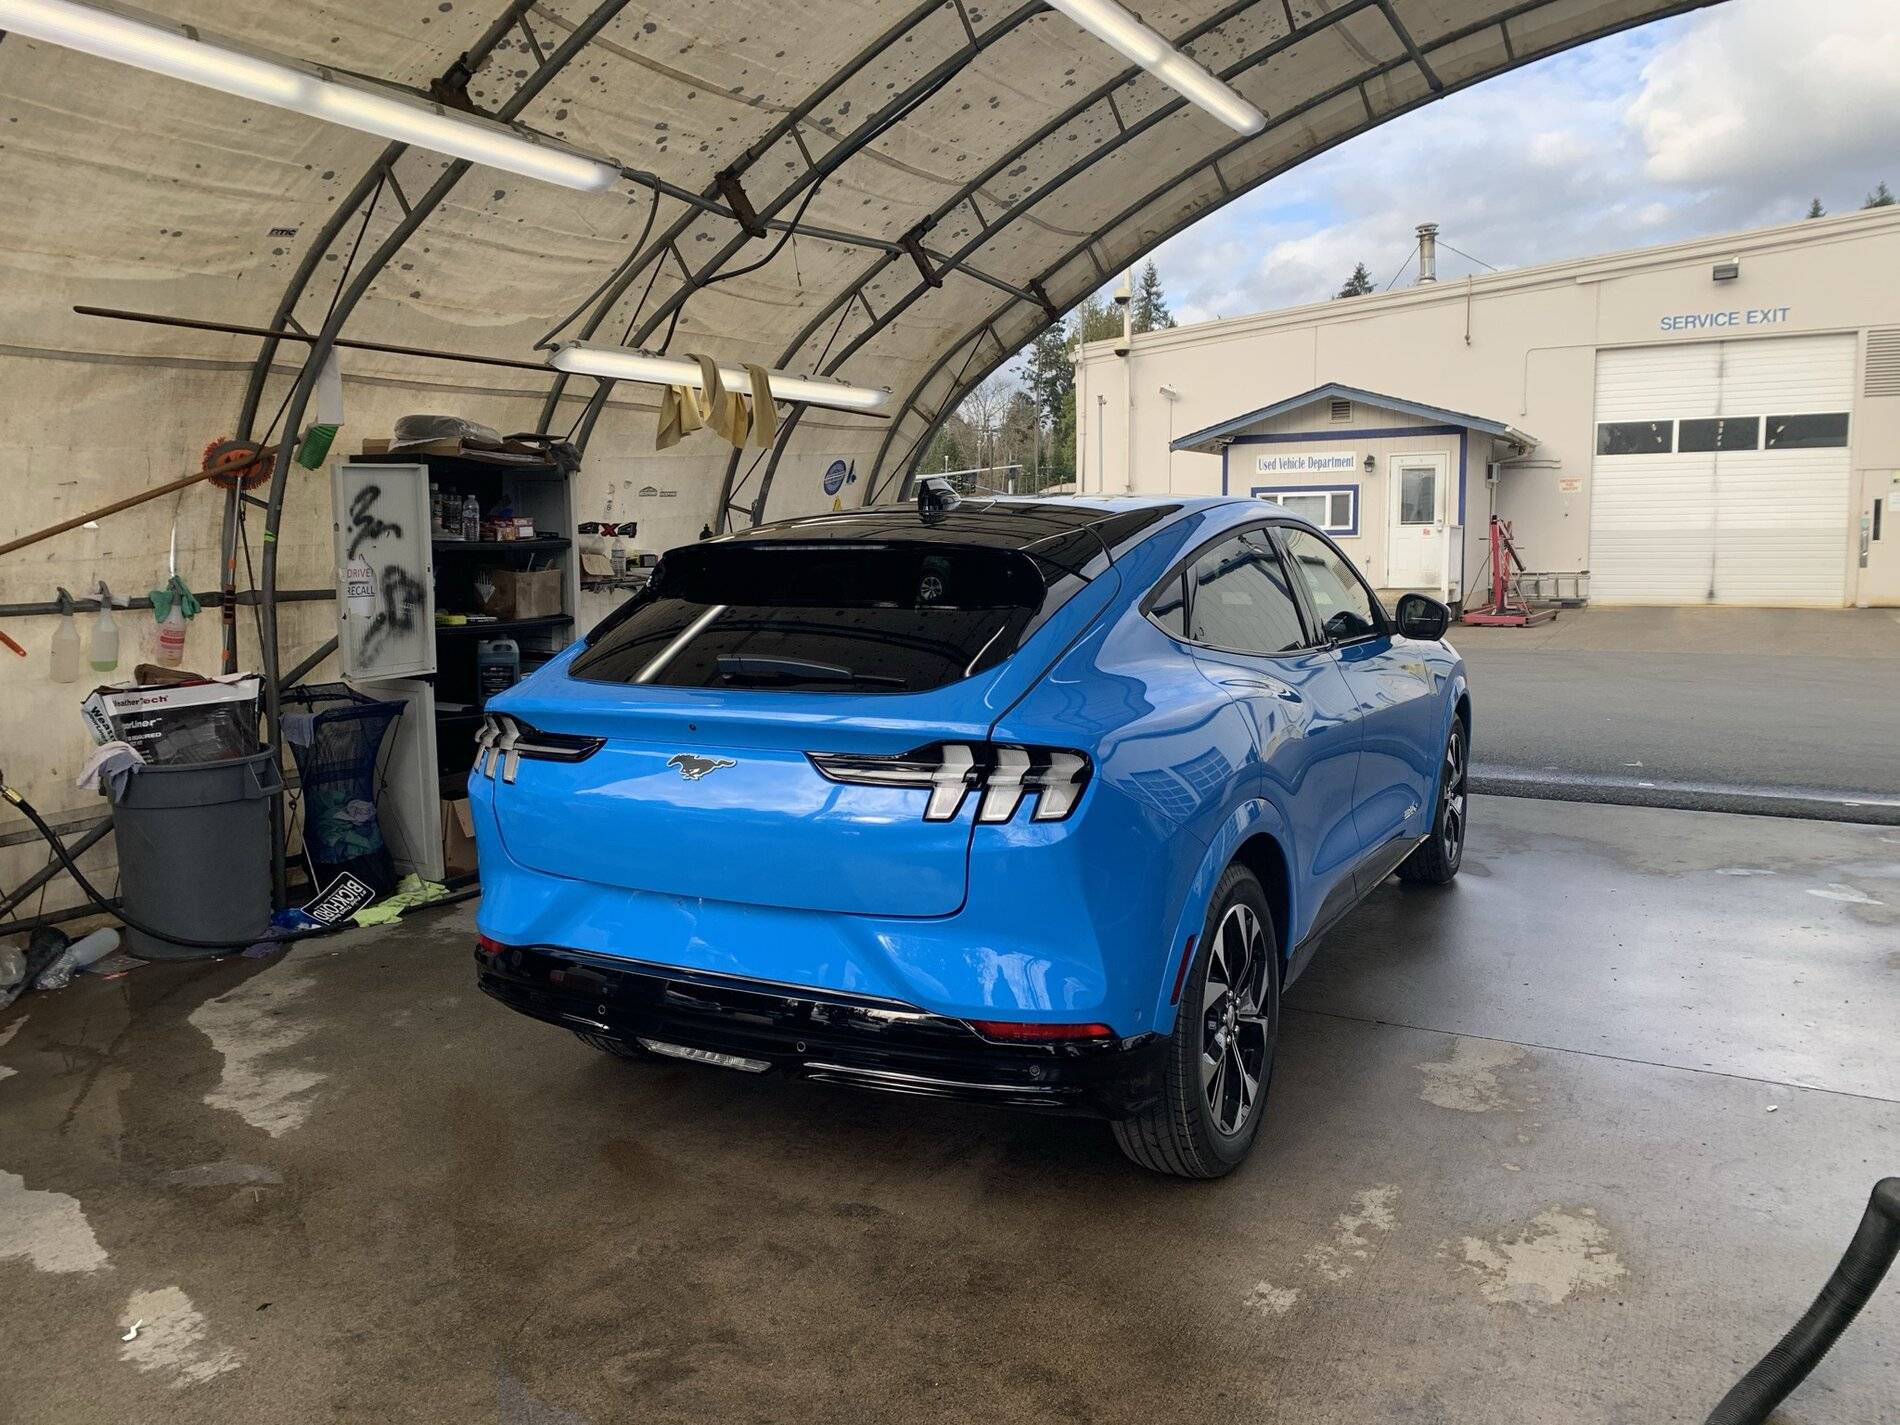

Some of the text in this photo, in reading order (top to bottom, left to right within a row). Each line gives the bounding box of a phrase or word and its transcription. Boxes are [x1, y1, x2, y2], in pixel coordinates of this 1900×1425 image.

[1660, 307, 1791, 331] SERVICE EXIT
[1258, 455, 1354, 471] Used Vehicle Department
[346, 568, 371, 578] DRIVE
[312, 879, 364, 921] BICKFORD
